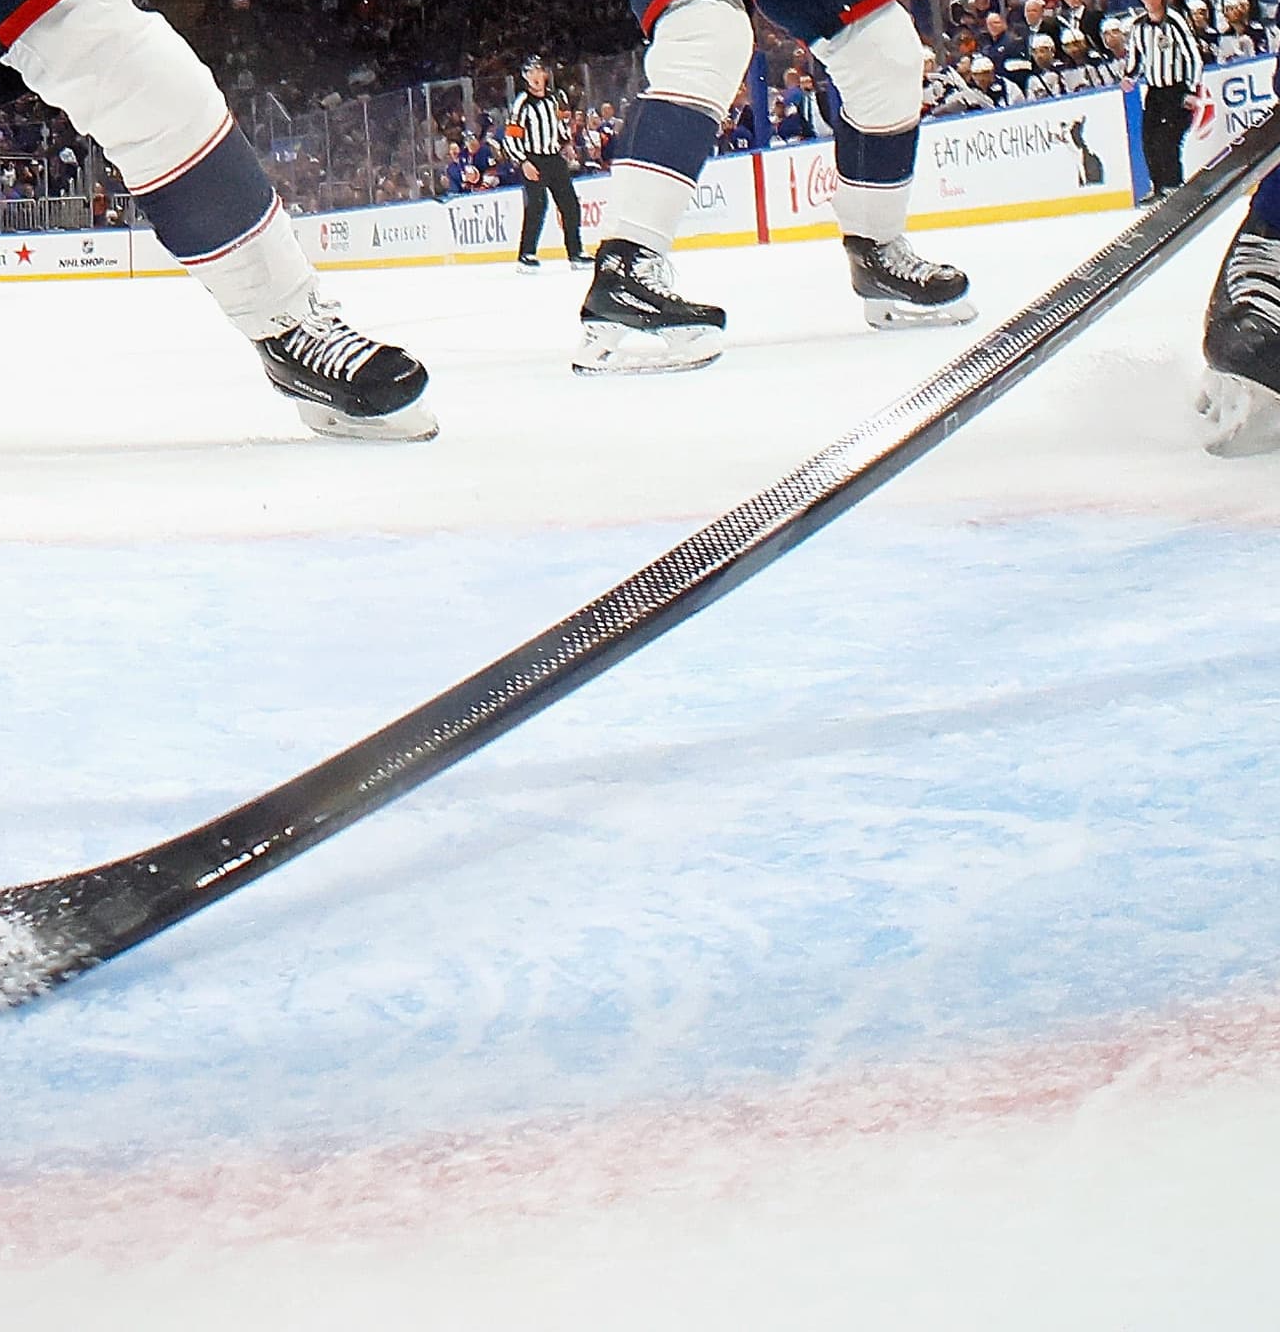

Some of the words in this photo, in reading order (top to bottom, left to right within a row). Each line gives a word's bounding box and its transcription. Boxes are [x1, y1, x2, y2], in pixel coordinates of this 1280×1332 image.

[1223, 74, 1273, 108] GL
[1225, 108, 1274, 135] IND
[934, 135, 960, 169] EAT
[966, 130, 996, 167] MOR
[448, 201, 509, 245] VanEck
